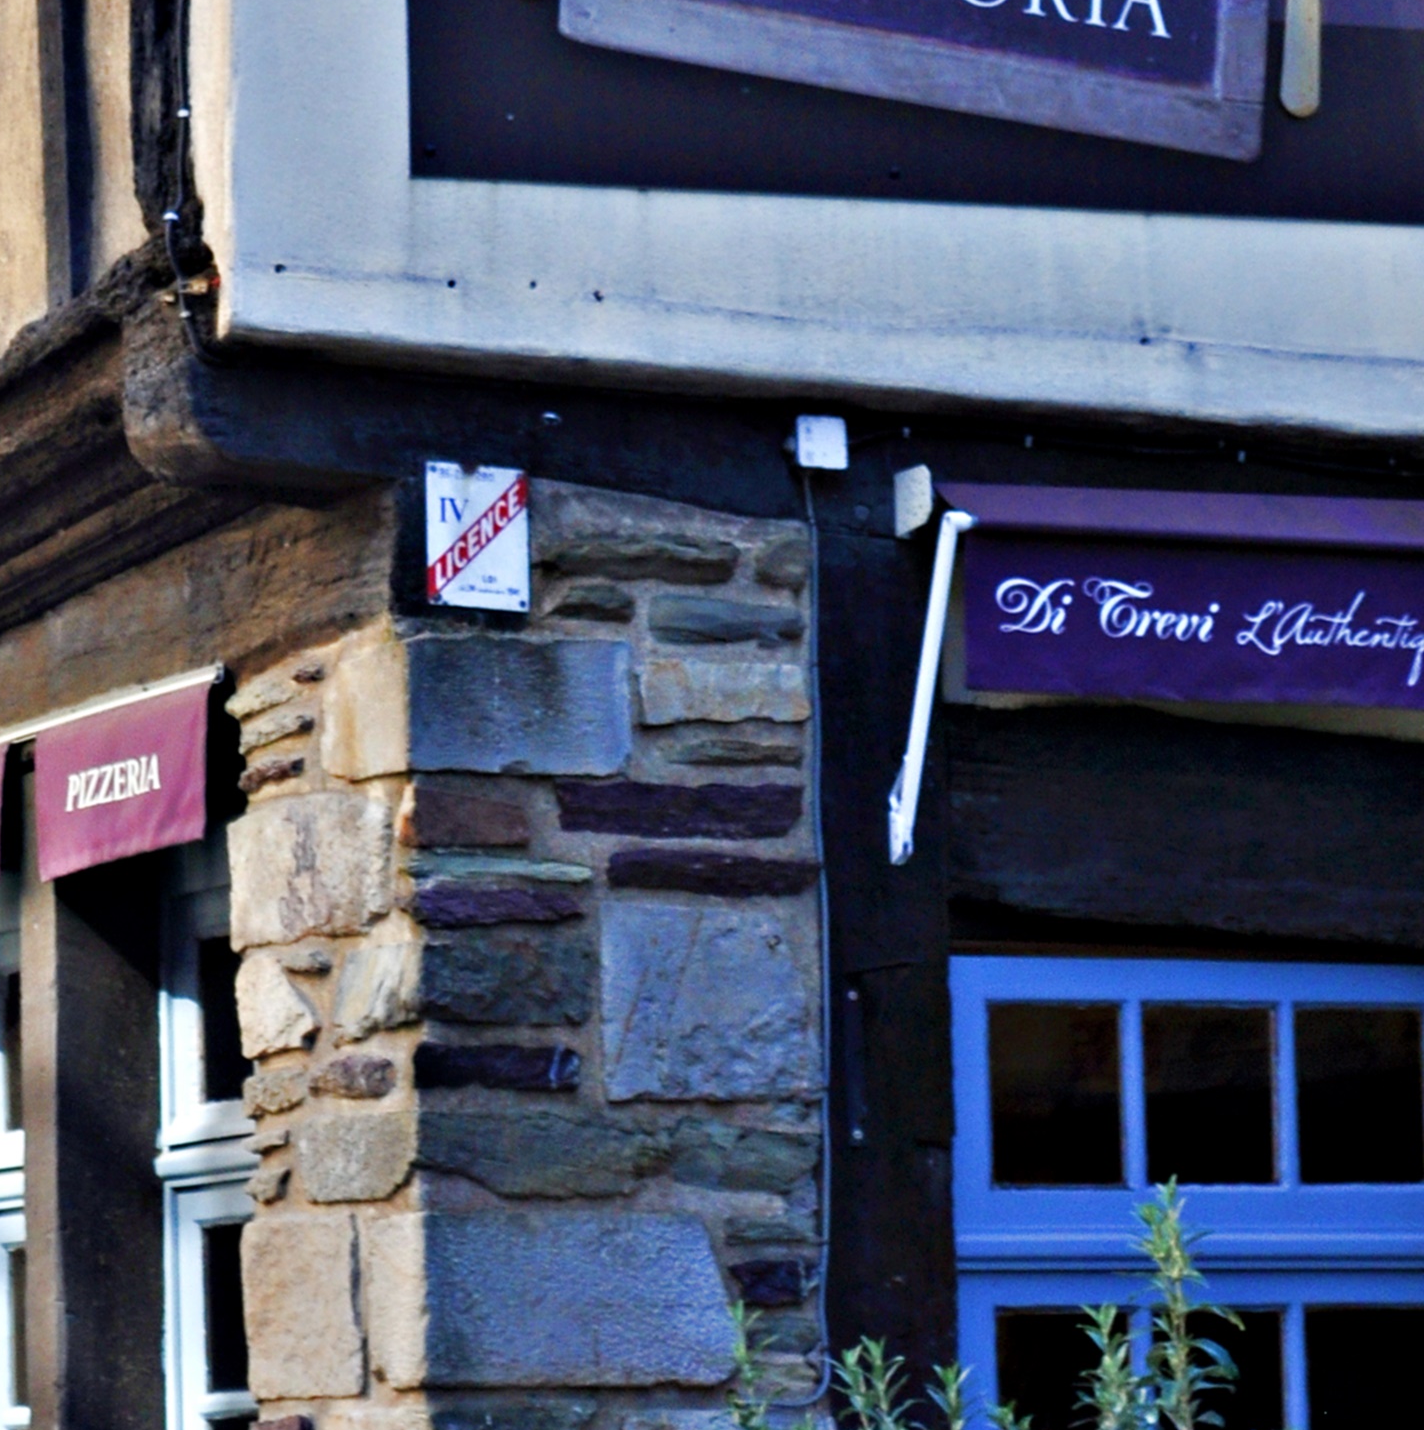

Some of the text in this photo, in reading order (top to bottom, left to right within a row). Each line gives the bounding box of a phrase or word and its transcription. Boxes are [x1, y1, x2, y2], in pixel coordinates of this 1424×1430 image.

[435, 483, 521, 590] LICENCE
[440, 497, 469, 523] IV
[995, 577, 1075, 634] Di
[1083, 576, 1220, 643] Trevi
[65, 753, 161, 812] PIZZERIA
